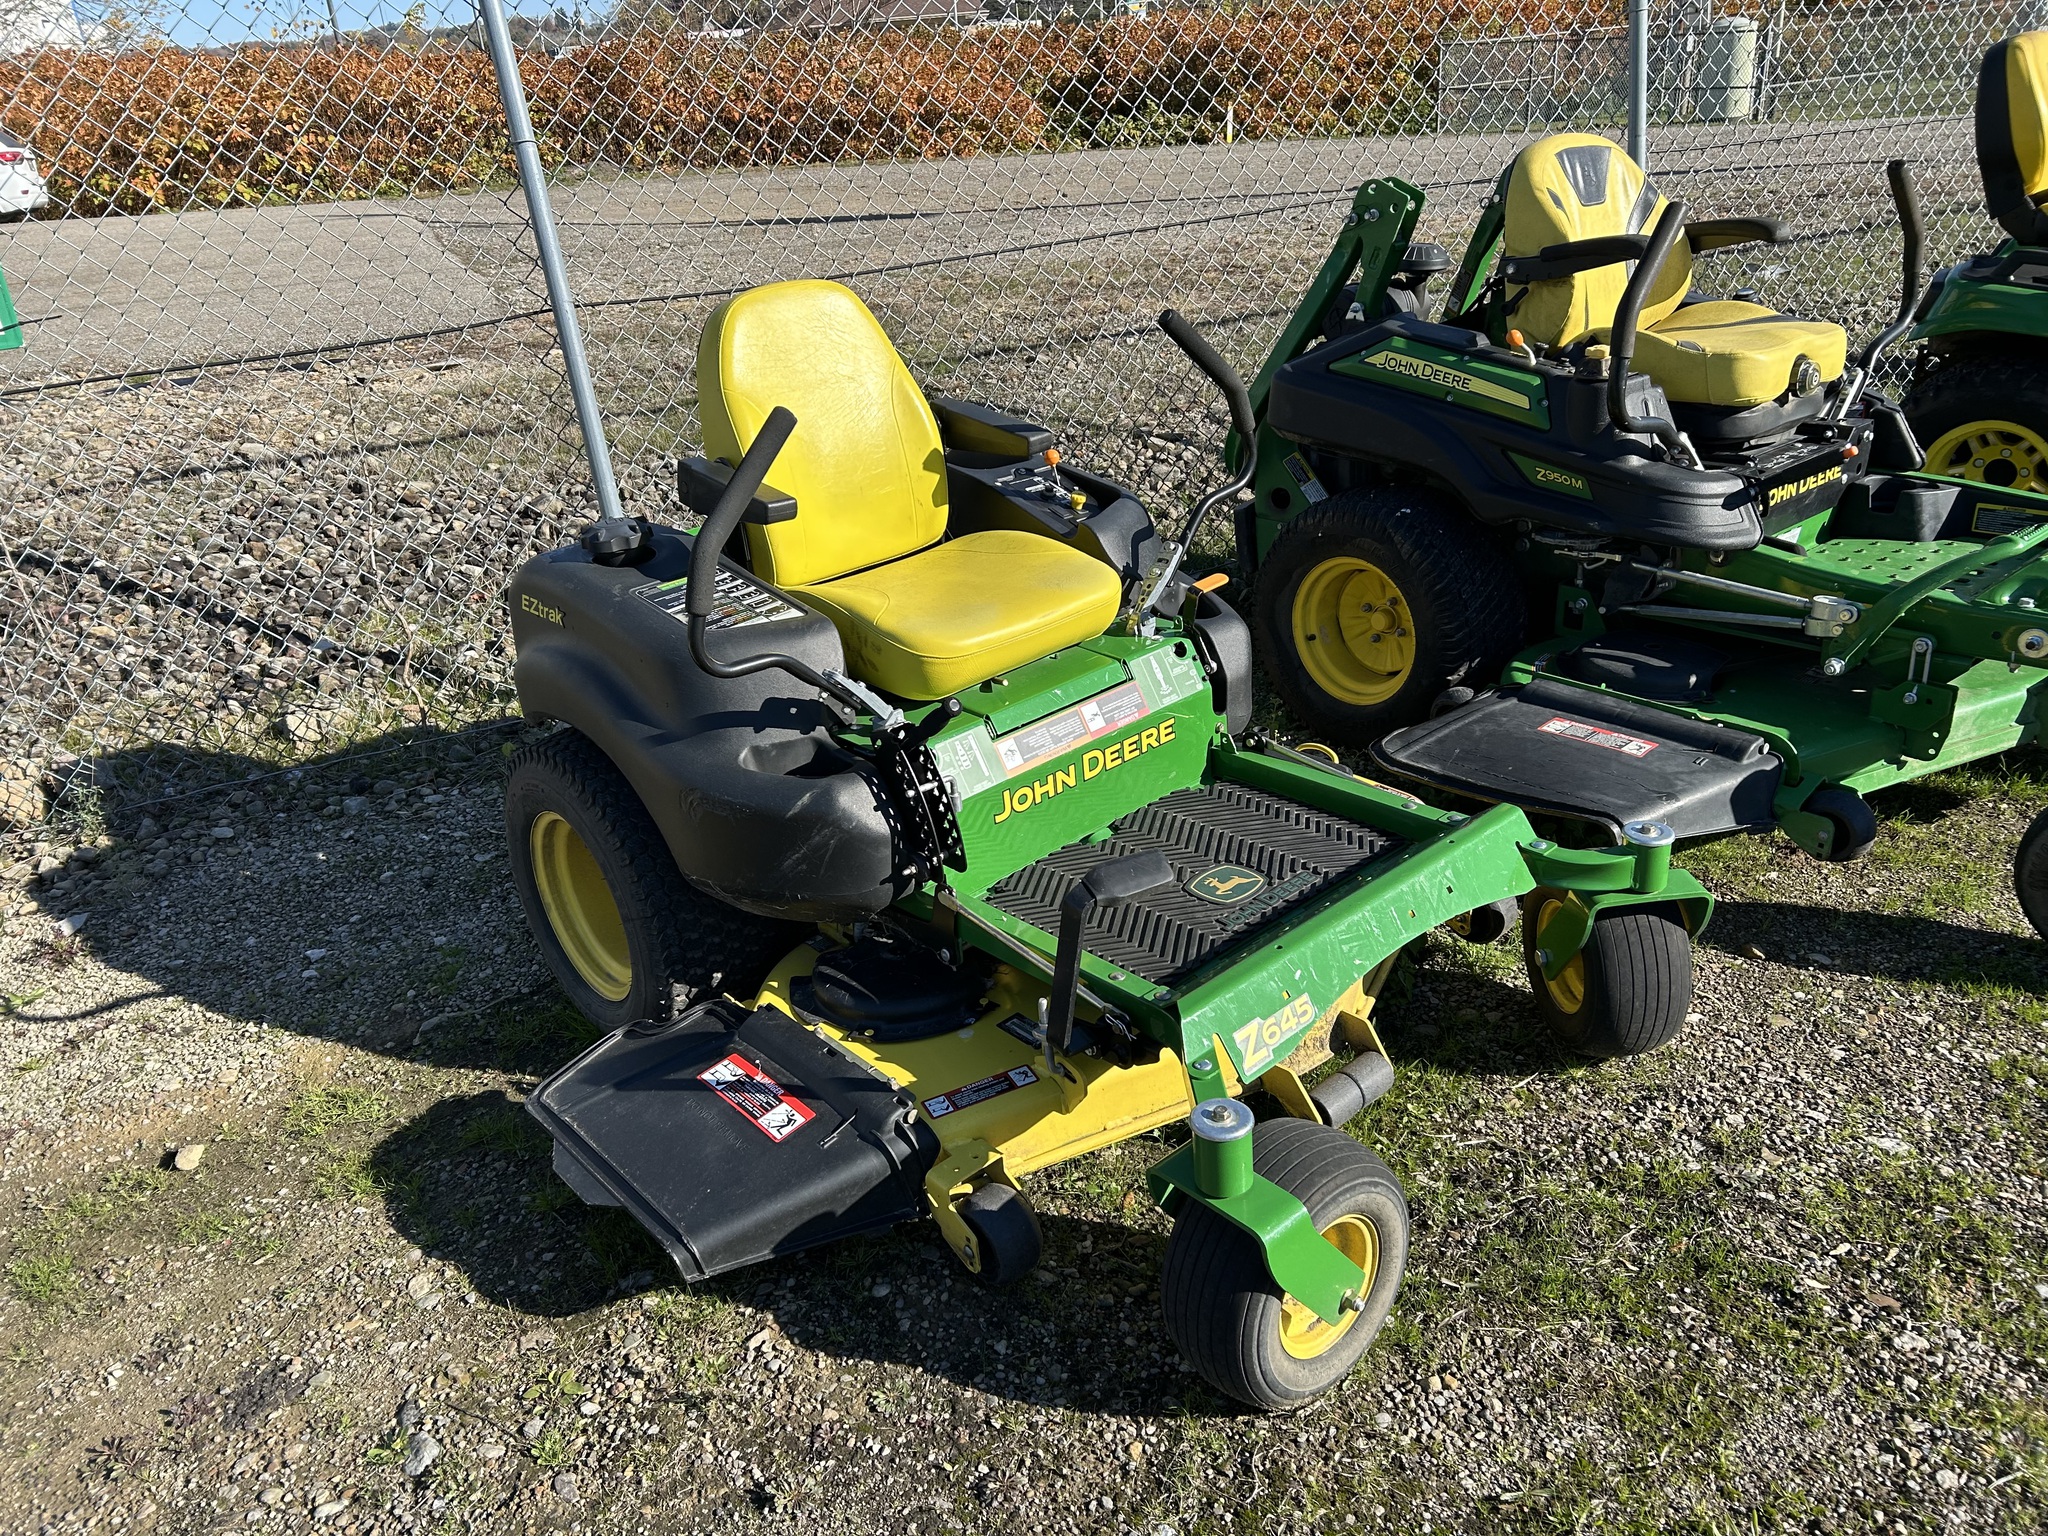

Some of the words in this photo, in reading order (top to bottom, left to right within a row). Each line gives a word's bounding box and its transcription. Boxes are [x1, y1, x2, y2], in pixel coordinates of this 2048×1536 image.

[1378, 352, 1421, 378] JOHN
[1421, 362, 1473, 390] DEERE
[1758, 481, 1798, 511] OHN
[1799, 466, 1842, 494] DEERE
[521, 593, 563, 626] EZtrak
[993, 763, 1077, 825] JOHN
[1081, 717, 1177, 783] DEERE
[1219, 900, 1267, 931] JOHN
[1258, 872, 1317, 907] DEERE
[1235, 998, 1315, 1070] Z645
[760, 1076, 785, 1096] DANGER
[965, 1076, 994, 1089] DANGER
